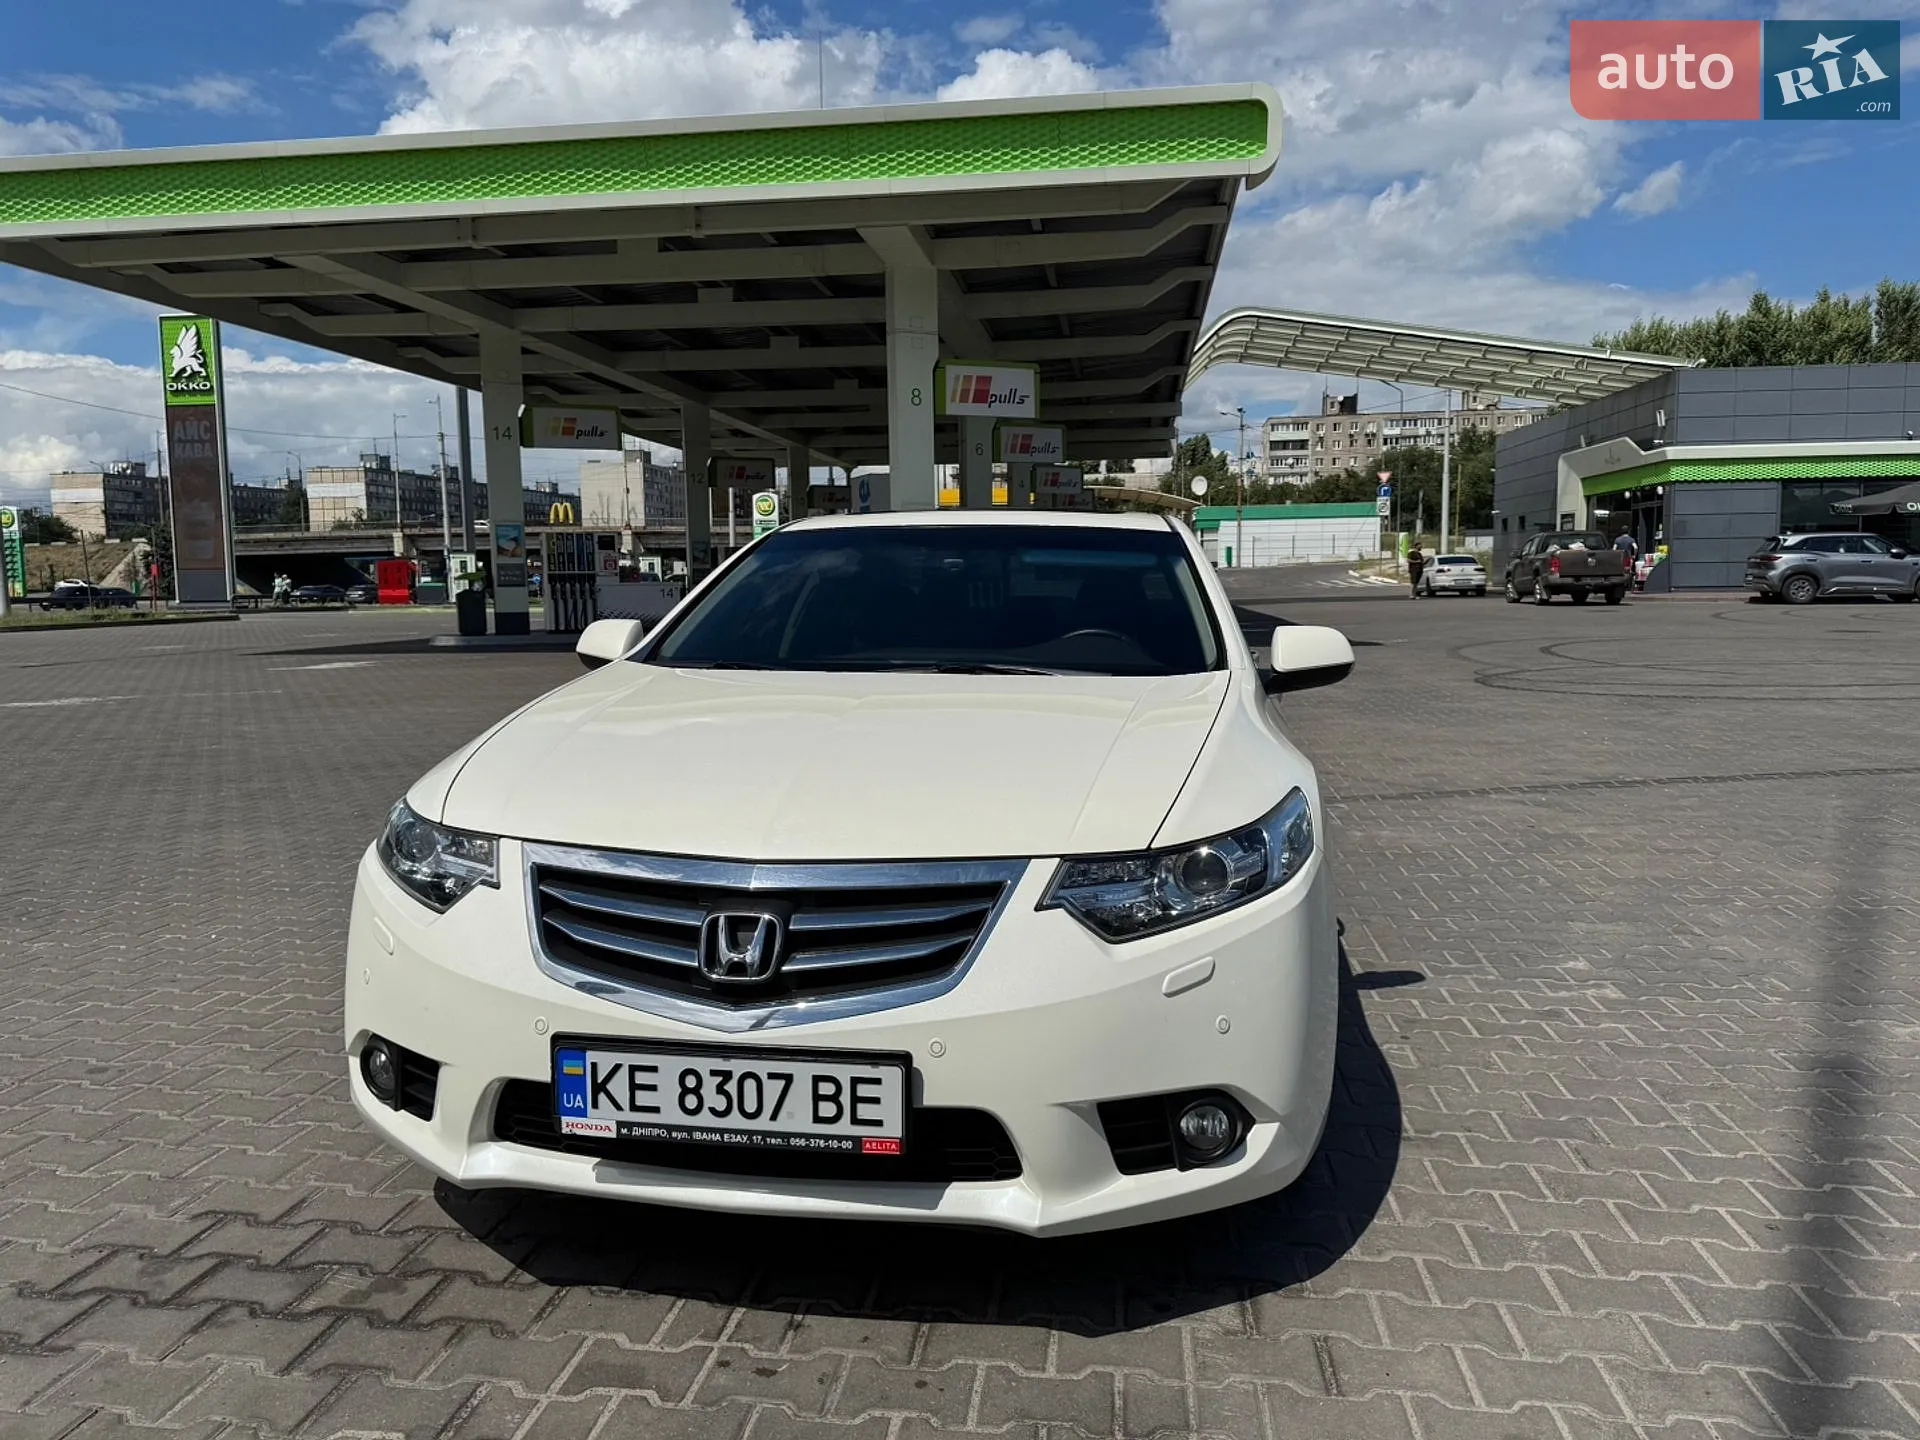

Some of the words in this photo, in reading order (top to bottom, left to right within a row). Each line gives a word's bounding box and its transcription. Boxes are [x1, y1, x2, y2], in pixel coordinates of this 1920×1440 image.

[166, 381, 211, 391] OKKO
[910, 387, 922, 406] 8
[988, 389, 1030, 408] pulls
[492, 425, 512, 441] 14
[975, 442, 984, 456] 6
[690, 472, 706, 484] 12
[563, 1093, 584, 1109] UA
[590, 1062, 661, 1114] KE
[677, 1068, 795, 1122] 8307
[811, 1074, 885, 1128] BE
[565, 1121, 613, 1132] HONDA
[692, 1131, 722, 1142] ІВАНА
[864, 1141, 898, 1151] AELITA
